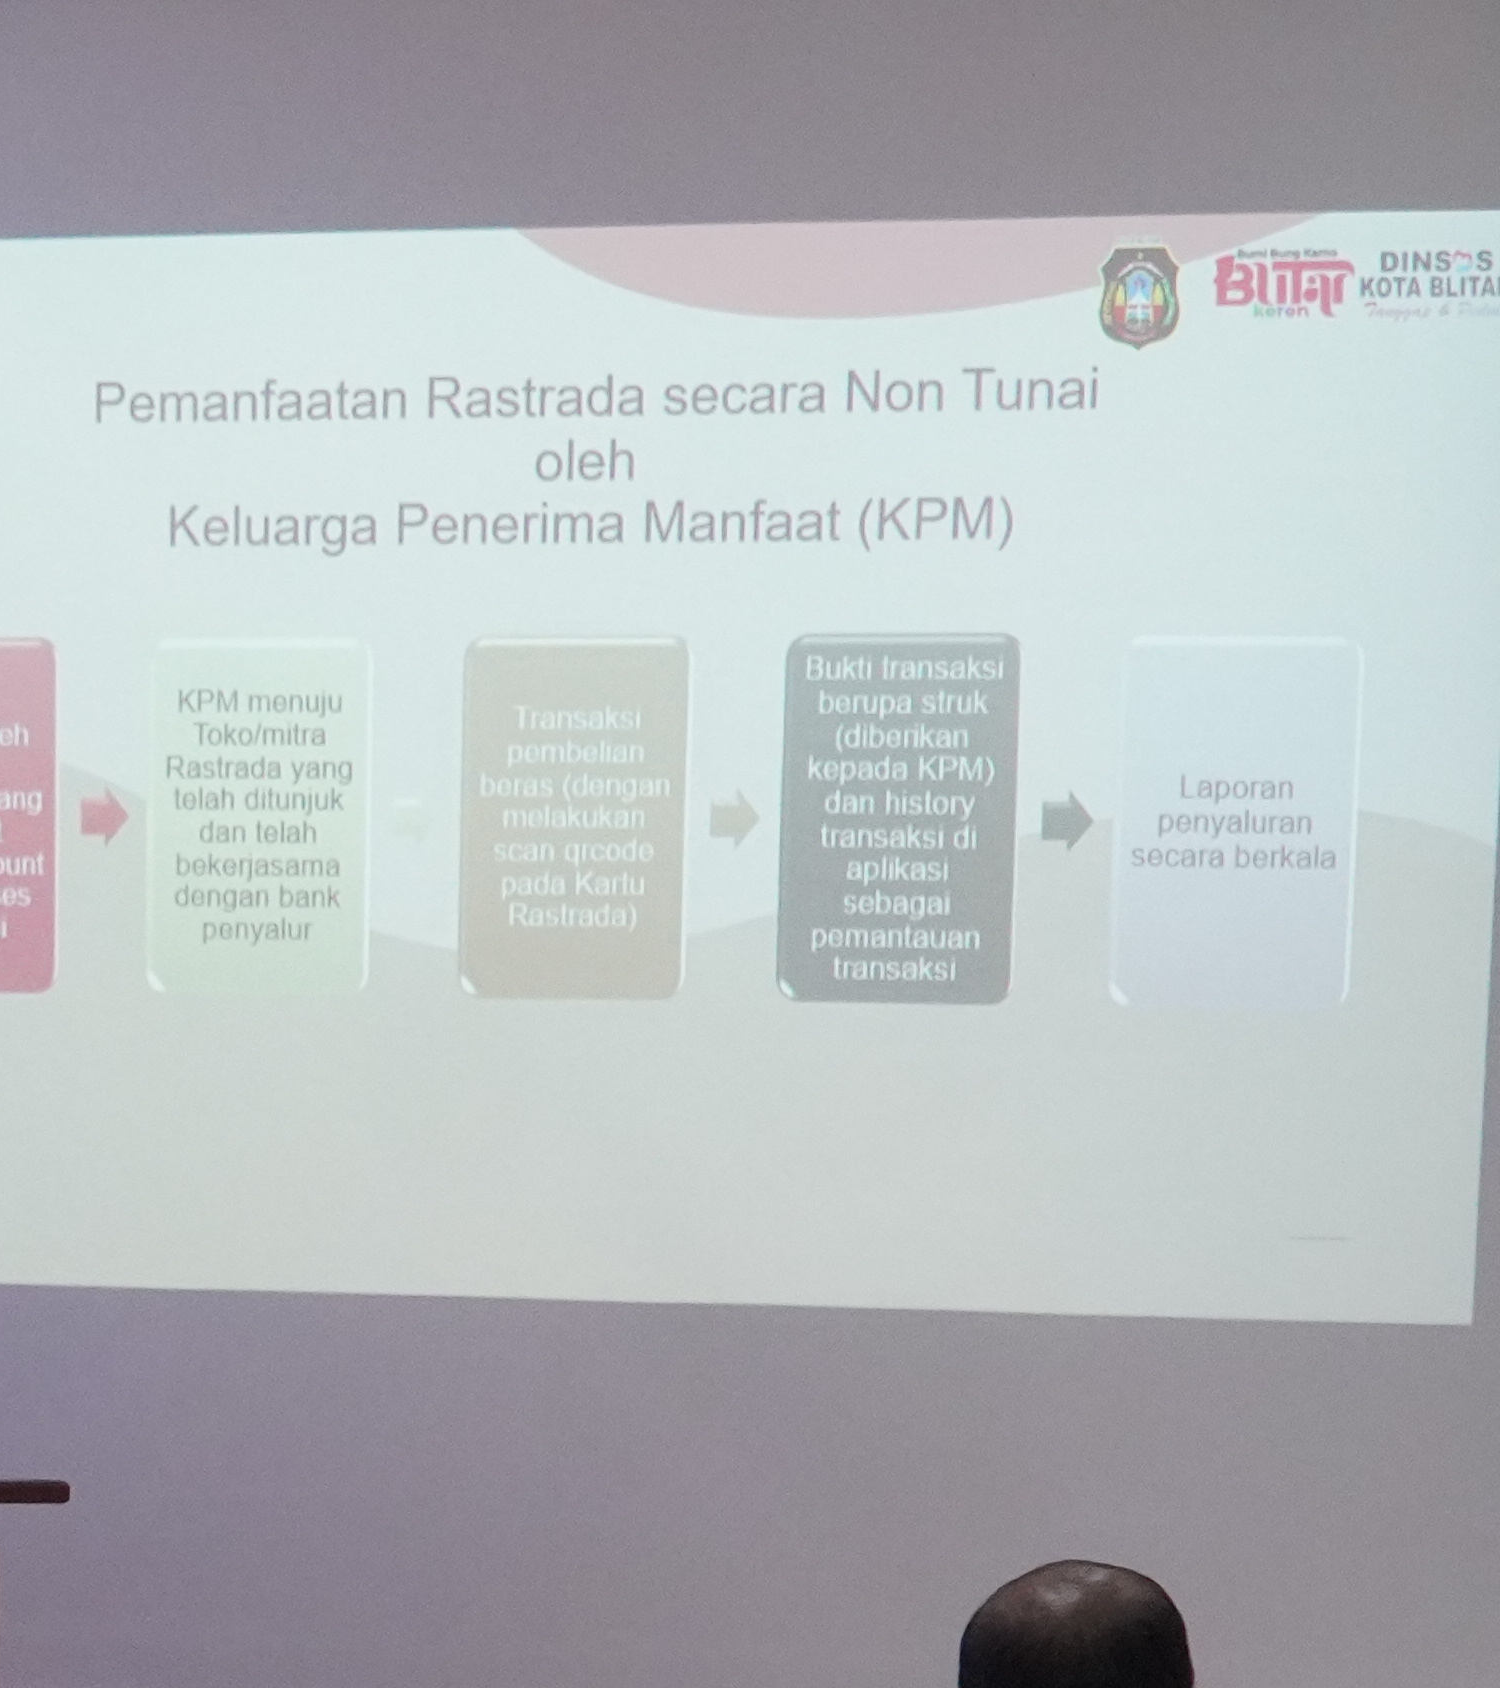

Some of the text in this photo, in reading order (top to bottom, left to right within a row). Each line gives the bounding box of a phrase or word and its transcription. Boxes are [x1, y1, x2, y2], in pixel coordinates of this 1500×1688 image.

[1360, 277, 1421, 297] KOTA
[94, 367, 1100, 424] Pemanfaatan Rastrada secara Non Tunai
[534, 441, 636, 483] oleh
[168, 495, 1014, 556] Keluarga Penerima Manfaat (KPM)
[806, 655, 1004, 680] Bukti transaksi
[178, 689, 343, 717] KPM menuju
[818, 689, 989, 719] berupa struk
[513, 705, 642, 731] Transaksi
[194, 722, 325, 746] Toko/mitra
[835, 723, 969, 754] (diberikan
[507, 740, 645, 767] pembelian
[166, 755, 353, 785] Rastrada yang
[808, 755, 996, 787] kepada KPM)
[174, 788, 344, 815] telah ditunjuk
[480, 773, 671, 803] beras (dengan
[1180, 774, 1293, 804] Laporan
[502, 805, 645, 829] melakukan
[824, 791, 975, 822] dan history
[199, 820, 317, 844] dan telah
[820, 823, 977, 850] transaksi di
[1158, 810, 1312, 838] penyaluran
[176, 853, 340, 881] bekerjasama
[493, 838, 654, 868] scan qrcode
[1131, 844, 1336, 870] secara berkala
[846, 857, 949, 886] aplikasi
[174, 885, 340, 913] dengan bank
[501, 872, 645, 900] pada Kartu
[508, 903, 637, 931] Rastrada)
[843, 891, 951, 920] sebagai
[202, 917, 312, 945] penyalur
[811, 927, 981, 955] pemantauan
[833, 957, 956, 982] transaksi
